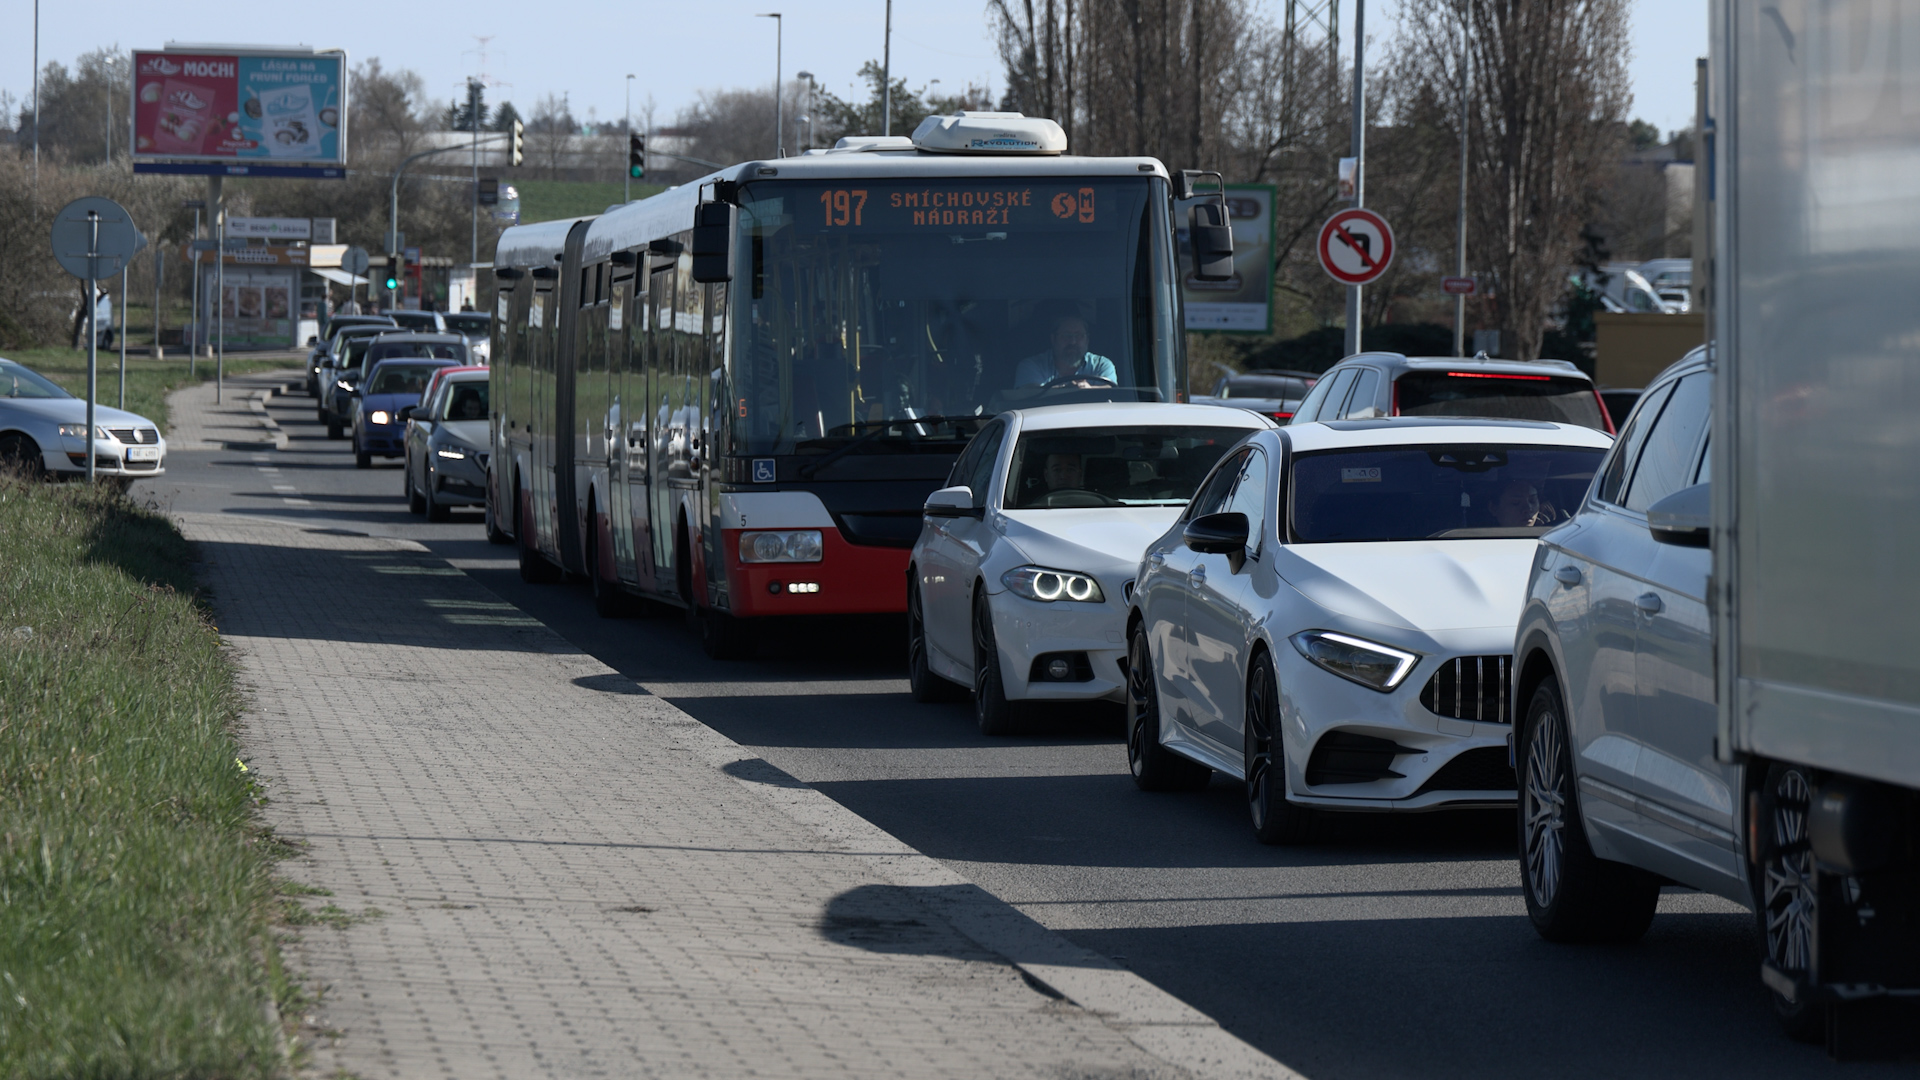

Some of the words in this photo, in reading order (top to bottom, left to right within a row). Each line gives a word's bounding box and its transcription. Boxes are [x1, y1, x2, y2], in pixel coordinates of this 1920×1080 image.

[184, 62, 234, 78] MOCHI
[261, 60, 297, 71] LÁSKA
[300, 61, 316, 72] NA
[249, 71, 283, 82] PRVNÍ
[286, 72, 328, 83] POHLED
[971, 139, 1038, 147] REVOLUTION
[890, 188, 1032, 207] SMÍCHOVSKÉ
[820, 190, 868, 226] 197
[913, 207, 1010, 225] NÁDRAŽÍ
[739, 398, 747, 418] 6
[741, 514, 747, 527] 5
